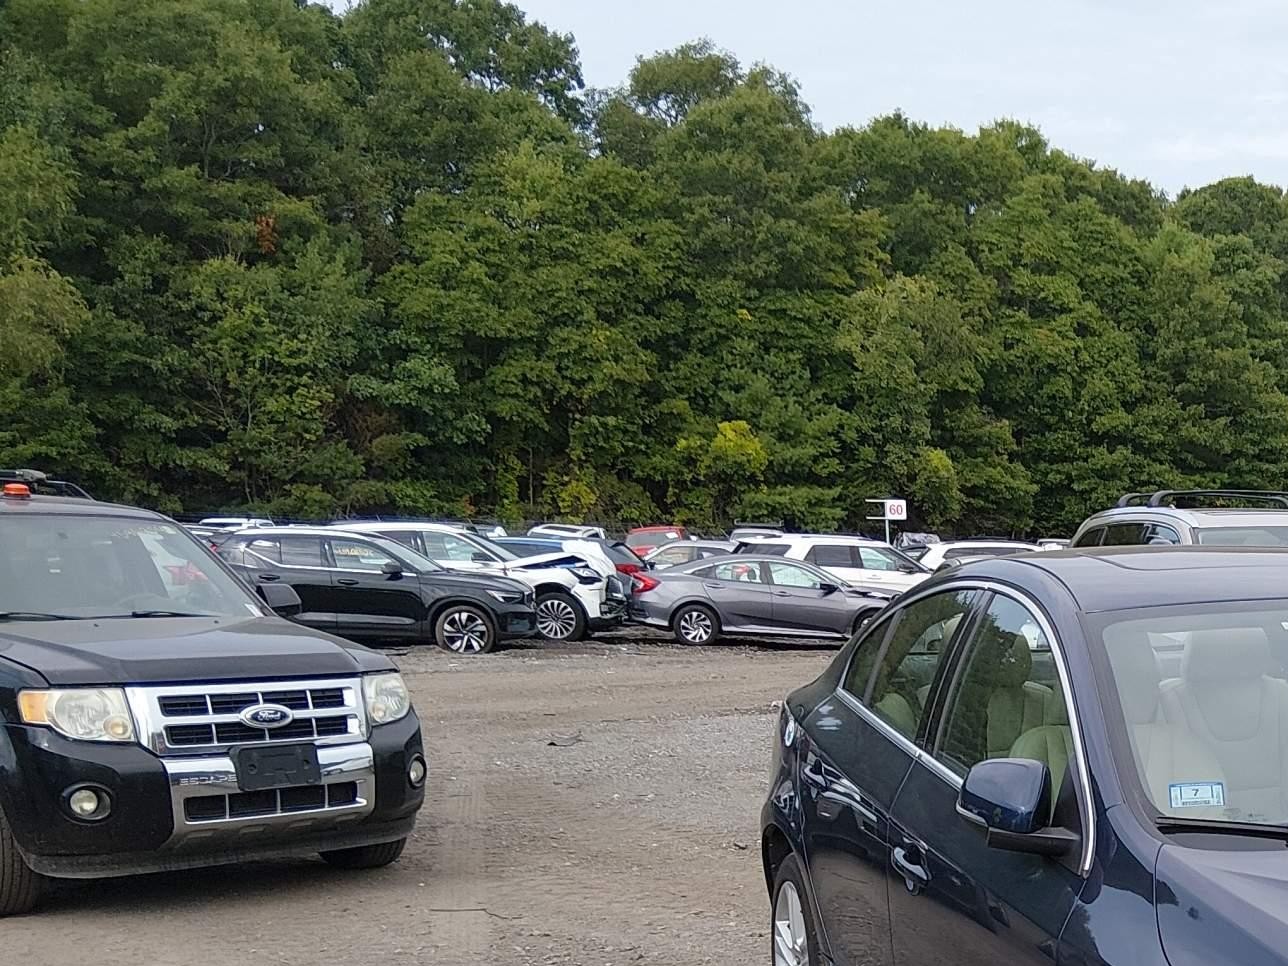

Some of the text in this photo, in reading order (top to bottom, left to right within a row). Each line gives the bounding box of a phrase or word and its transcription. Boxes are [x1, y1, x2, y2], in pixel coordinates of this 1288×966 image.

[889, 504, 903, 516] 60
[257, 710, 281, 721] Ford
[180, 774, 238, 786] ESCAPE
[1191, 788, 1200, 797] 7
